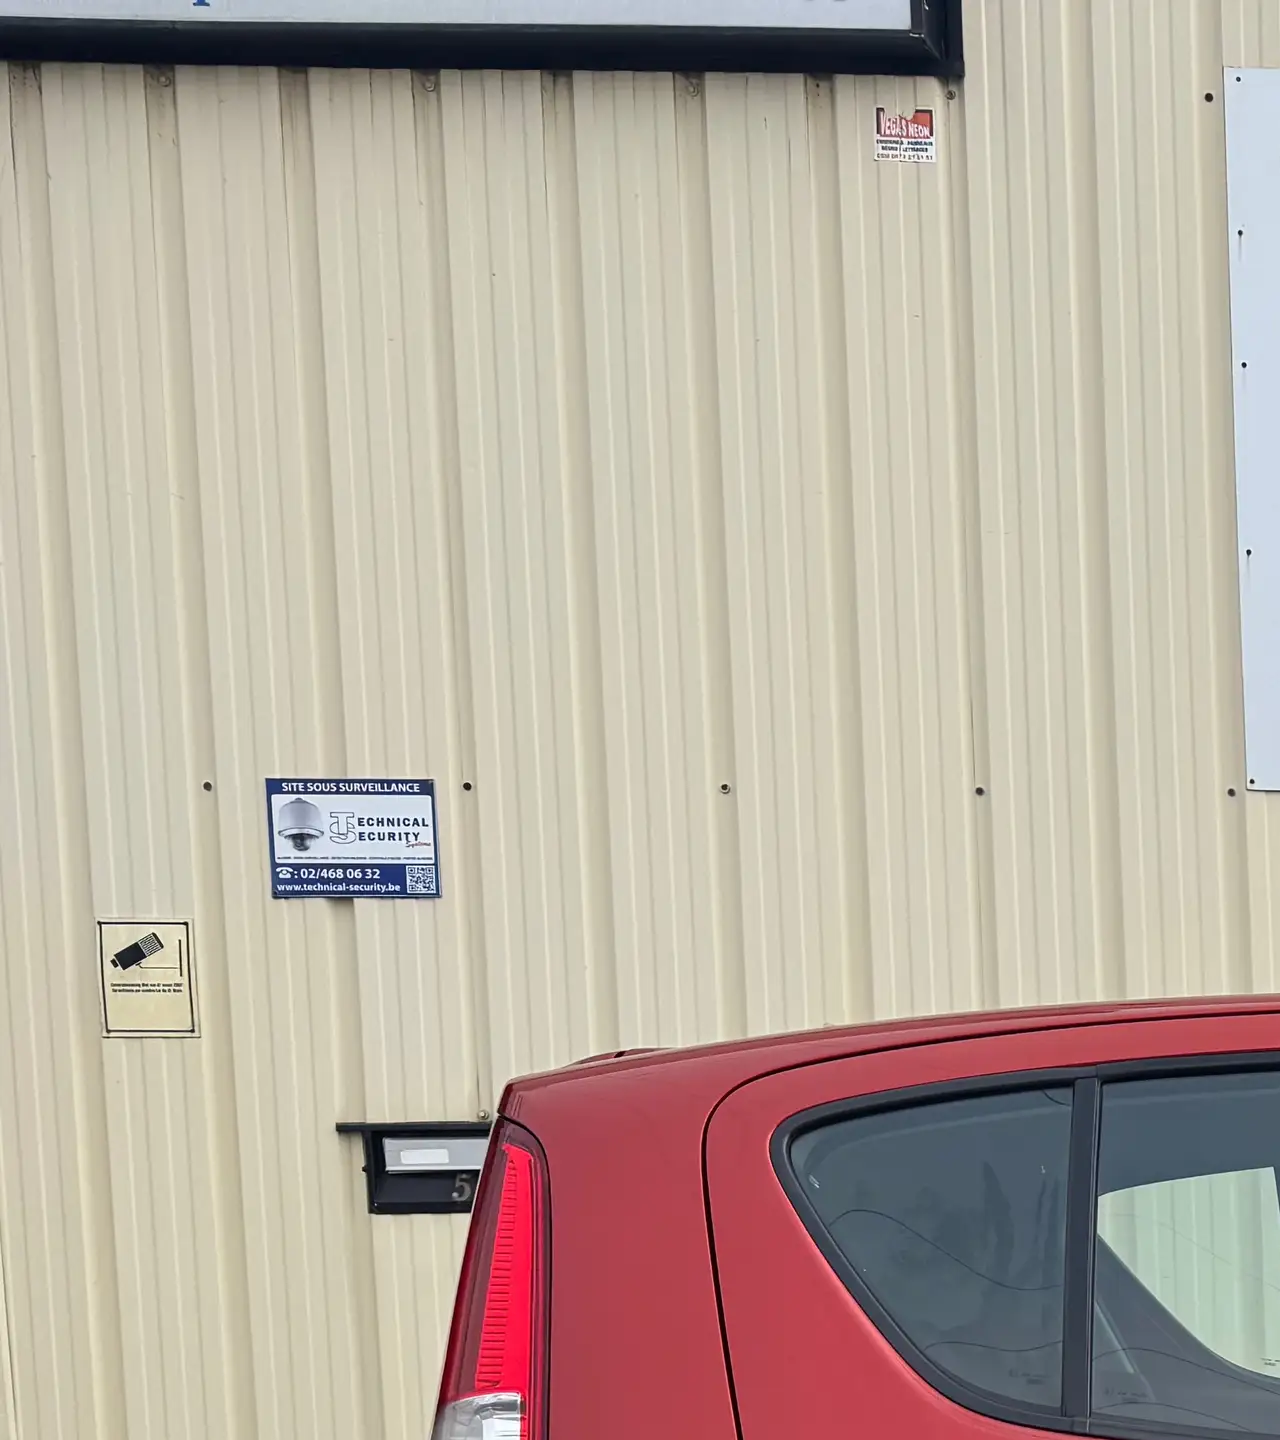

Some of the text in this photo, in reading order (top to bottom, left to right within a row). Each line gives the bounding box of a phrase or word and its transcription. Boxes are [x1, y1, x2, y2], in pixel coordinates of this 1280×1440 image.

[880, 111, 930, 138] VEGAS NEON
[281, 782, 420, 792] SITE SOUS SURVEILLANCE
[300, 868, 344, 879] 02/468
[346, 868, 363, 879] 06
[364, 868, 381, 879] 32
[276, 882, 401, 893] www.technical-security.be
[451, 1173, 472, 1202] 5
